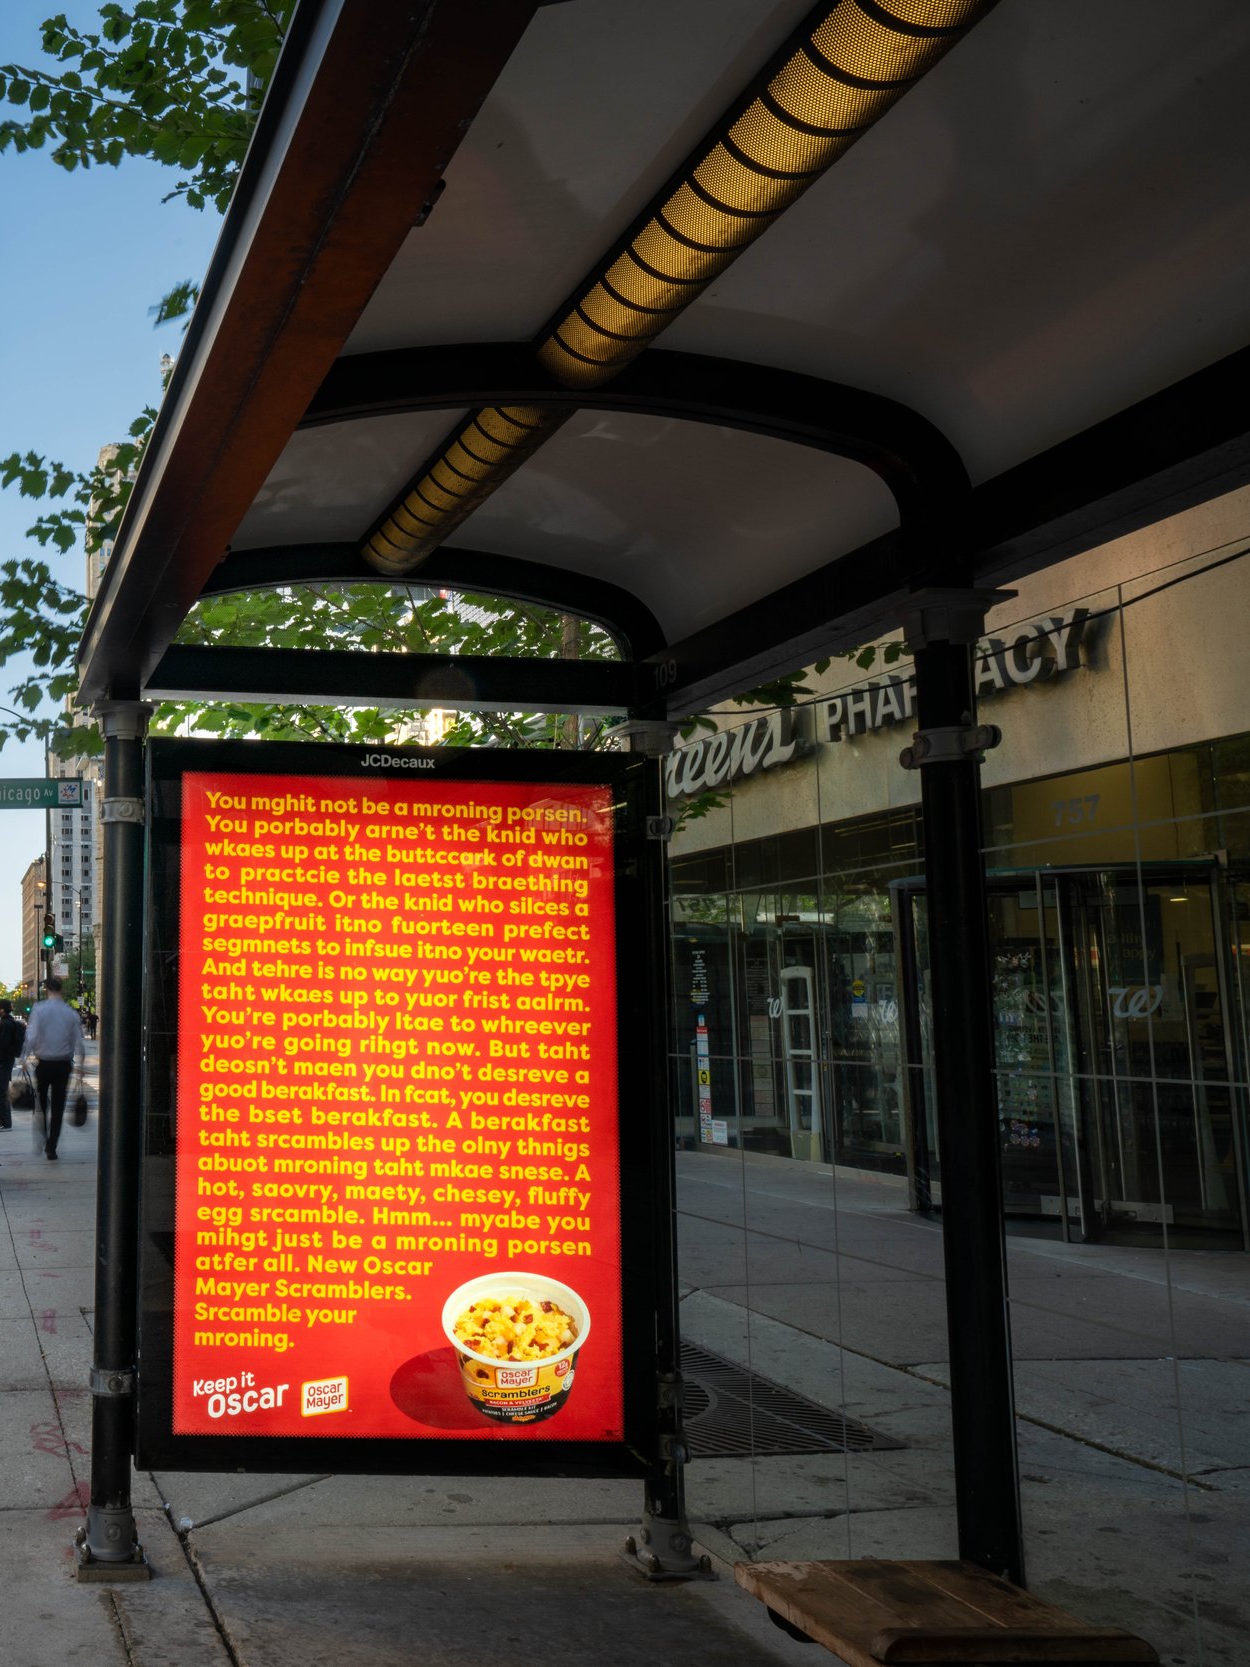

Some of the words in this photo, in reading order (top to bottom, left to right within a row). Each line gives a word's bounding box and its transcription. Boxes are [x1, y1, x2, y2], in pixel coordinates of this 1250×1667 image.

[654, 659, 677, 690] 109
[361, 754, 435, 768] JCDecaux
[664, 708, 796, 798] reens
[44, 789, 53, 797] Av
[206, 792, 246, 809] You
[252, 794, 316, 815] mghit
[321, 798, 358, 813] not
[363, 798, 390, 814] be
[394, 803, 408, 815] a
[414, 802, 502, 824] mroning
[508, 808, 587, 824] porsen.
[1052, 794, 1101, 828] 757
[206, 815, 247, 832] You
[255, 818, 360, 841] porbably
[366, 823, 435, 840] arne't
[442, 824, 480, 841] the
[487, 826, 535, 844] knid
[542, 828, 587, 846] who
[205, 839, 275, 857] wkaes
[281, 846, 308, 863] up
[314, 845, 338, 860] at
[344, 844, 381, 861] the
[387, 845, 496, 866] buttccark
[502, 850, 525, 866] of
[528, 851, 588, 869] dwan
[204, 864, 230, 879] to
[241, 866, 340, 884] practcie
[348, 868, 386, 885] the
[395, 869, 465, 888] laetst
[473, 872, 588, 898] braething
[204, 887, 322, 910] technique.
[329, 891, 356, 908] Or
[361, 892, 398, 909] the
[405, 893, 452, 911] knid
[458, 895, 504, 913] who
[510, 897, 569, 915] silces
[575, 904, 588, 916] a
[204, 912, 326, 933] graepfruit
[336, 914, 382, 932] itno
[392, 916, 494, 936] fuorteen
[504, 922, 590, 942] prefect
[203, 938, 311, 956] segmnets
[316, 939, 340, 955] to
[346, 938, 412, 958] infsue
[418, 941, 462, 959] itno
[467, 947, 516, 964] your
[520, 948, 589, 964] waetr.
[202, 1006, 276, 1025] You're
[283, 1010, 389, 1034] porbably
[396, 1012, 443, 1030] ltae
[450, 1016, 475, 1032] to
[482, 1016, 590, 1035] whreever
[201, 1032, 276, 1052] yuo're
[284, 1034, 351, 1057] going
[360, 1036, 418, 1058] rihgt
[428, 1042, 480, 1056] now.
[490, 1040, 530, 1058] But
[538, 1042, 590, 1060] taht
[200, 1054, 287, 1074] deosn't
[294, 1062, 356, 1076] maen
[363, 1064, 404, 1082] you
[411, 1062, 472, 1080] dno't
[478, 1064, 568, 1083] desreve
[575, 1071, 589, 1084] a
[200, 1080, 256, 1101] good
[262, 1081, 375, 1101] berakfast.
[381, 1085, 400, 1102] In
[405, 1085, 456, 1107] fcat,
[460, 1092, 498, 1109] you
[503, 1088, 590, 1108] desreve
[200, 1104, 240, 1122] the
[250, 1105, 302, 1124] bset
[312, 1107, 437, 1128] berakfast.
[446, 1112, 462, 1128] A
[471, 1112, 590, 1132] berakfast
[199, 1129, 250, 1146] taht
[257, 1132, 374, 1150] srcambles
[382, 1138, 410, 1156] up
[416, 1135, 456, 1152] the
[462, 1136, 511, 1159] olny
[517, 1138, 590, 1161] thnigs
[198, 1153, 268, 1172] abuot
[274, 1156, 367, 1180] mroning
[374, 1158, 424, 1176] taht
[430, 1160, 493, 1178] mkae
[500, 1166, 569, 1180] snese.
[575, 1164, 590, 1181] A
[198, 1177, 244, 1199] hot,
[252, 1184, 338, 1203] saovry,
[346, 1184, 426, 1205] maety,
[434, 1184, 520, 1208] chesey,
[528, 1186, 590, 1210] fluffy
[198, 1207, 242, 1226] egg
[250, 1206, 364, 1224] srcamble.
[374, 1207, 452, 1226] Hmm...
[461, 1210, 540, 1232] myabe
[547, 1216, 590, 1234] you
[198, 1228, 268, 1251] mihgt
[272, 1229, 322, 1252] just
[333, 1230, 362, 1248] be
[372, 1236, 386, 1249] a
[397, 1234, 497, 1257] mroning
[508, 1240, 591, 1258] porsen
[196, 1252, 258, 1270] atfer
[264, 1254, 300, 1272] all.
[308, 1255, 357, 1273] New
[364, 1256, 432, 1275] Oscar
[196, 1278, 270, 1300] Mayer
[276, 1279, 411, 1300] Scramblers.
[195, 1302, 301, 1322] Srcamble
[306, 1310, 356, 1327] your
[195, 1328, 294, 1352] mroning.
[193, 1376, 237, 1397] Keep
[241, 1372, 255, 1388] it
[501, 1376, 532, 1386] Mayer
[502, 1370, 532, 1378] Oscar
[208, 1384, 289, 1418] Oscar
[306, 1393, 343, 1409] Mayer
[308, 1382, 343, 1397] Oscar
[482, 1386, 550, 1398] Scramblers
